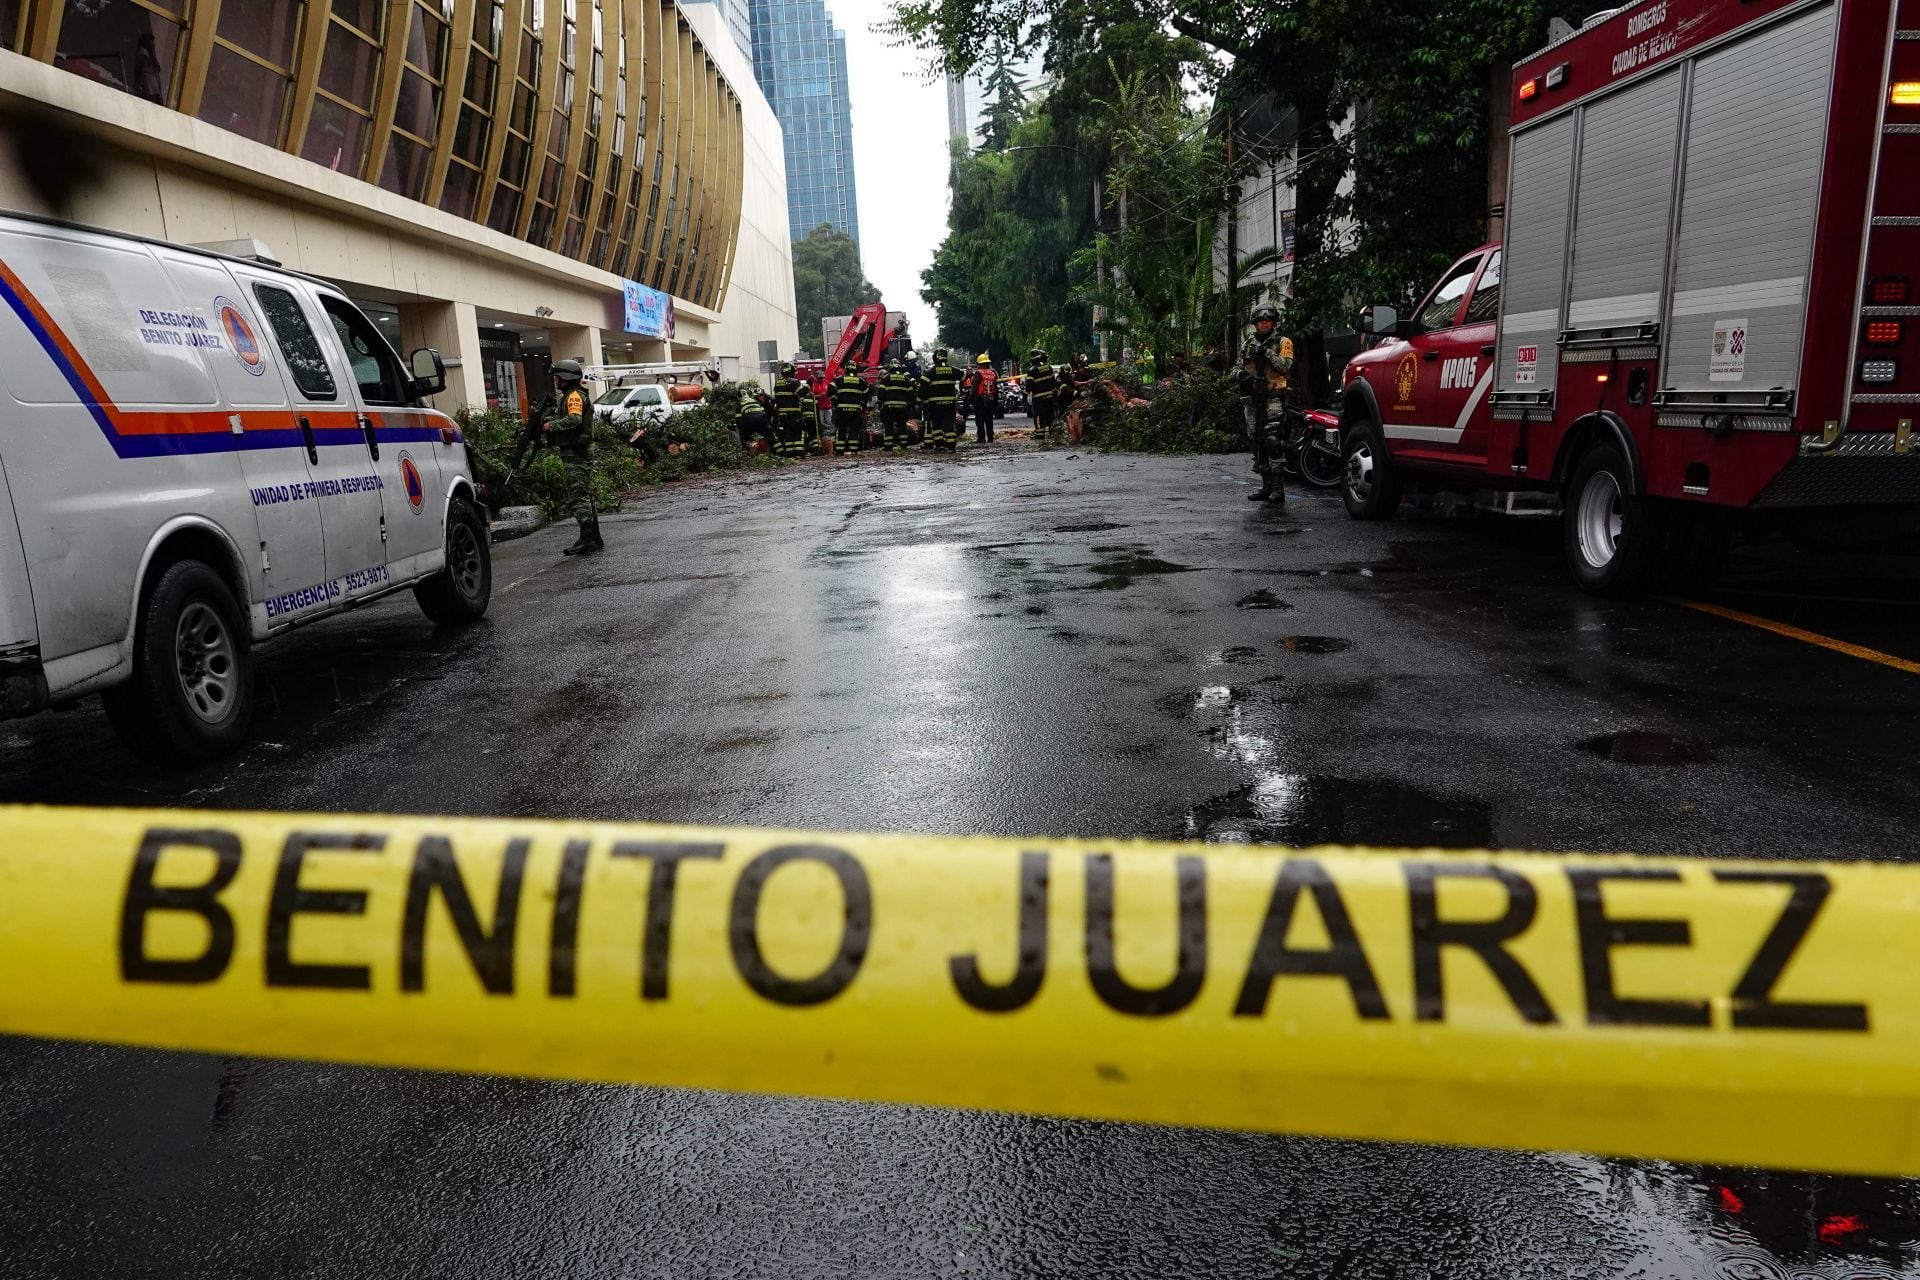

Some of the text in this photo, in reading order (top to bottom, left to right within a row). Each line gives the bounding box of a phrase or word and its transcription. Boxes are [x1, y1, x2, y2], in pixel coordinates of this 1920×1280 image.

[1627, 1, 1667, 38] BOMBEROS
[1612, 46, 1637, 76] CIUDAD
[1638, 40, 1649, 64] DE
[140, 328, 223, 349] BENITO JUAREZ
[1519, 349, 1536, 361] 911
[1440, 357, 1479, 389] MP005
[251, 475, 384, 507] UNIDAD DE PRIMERA RESPUESTA
[265, 565, 388, 618] EMERGENCIAS 5523-9873
[118, 826, 1873, 1033] BENITO JUAREZ
